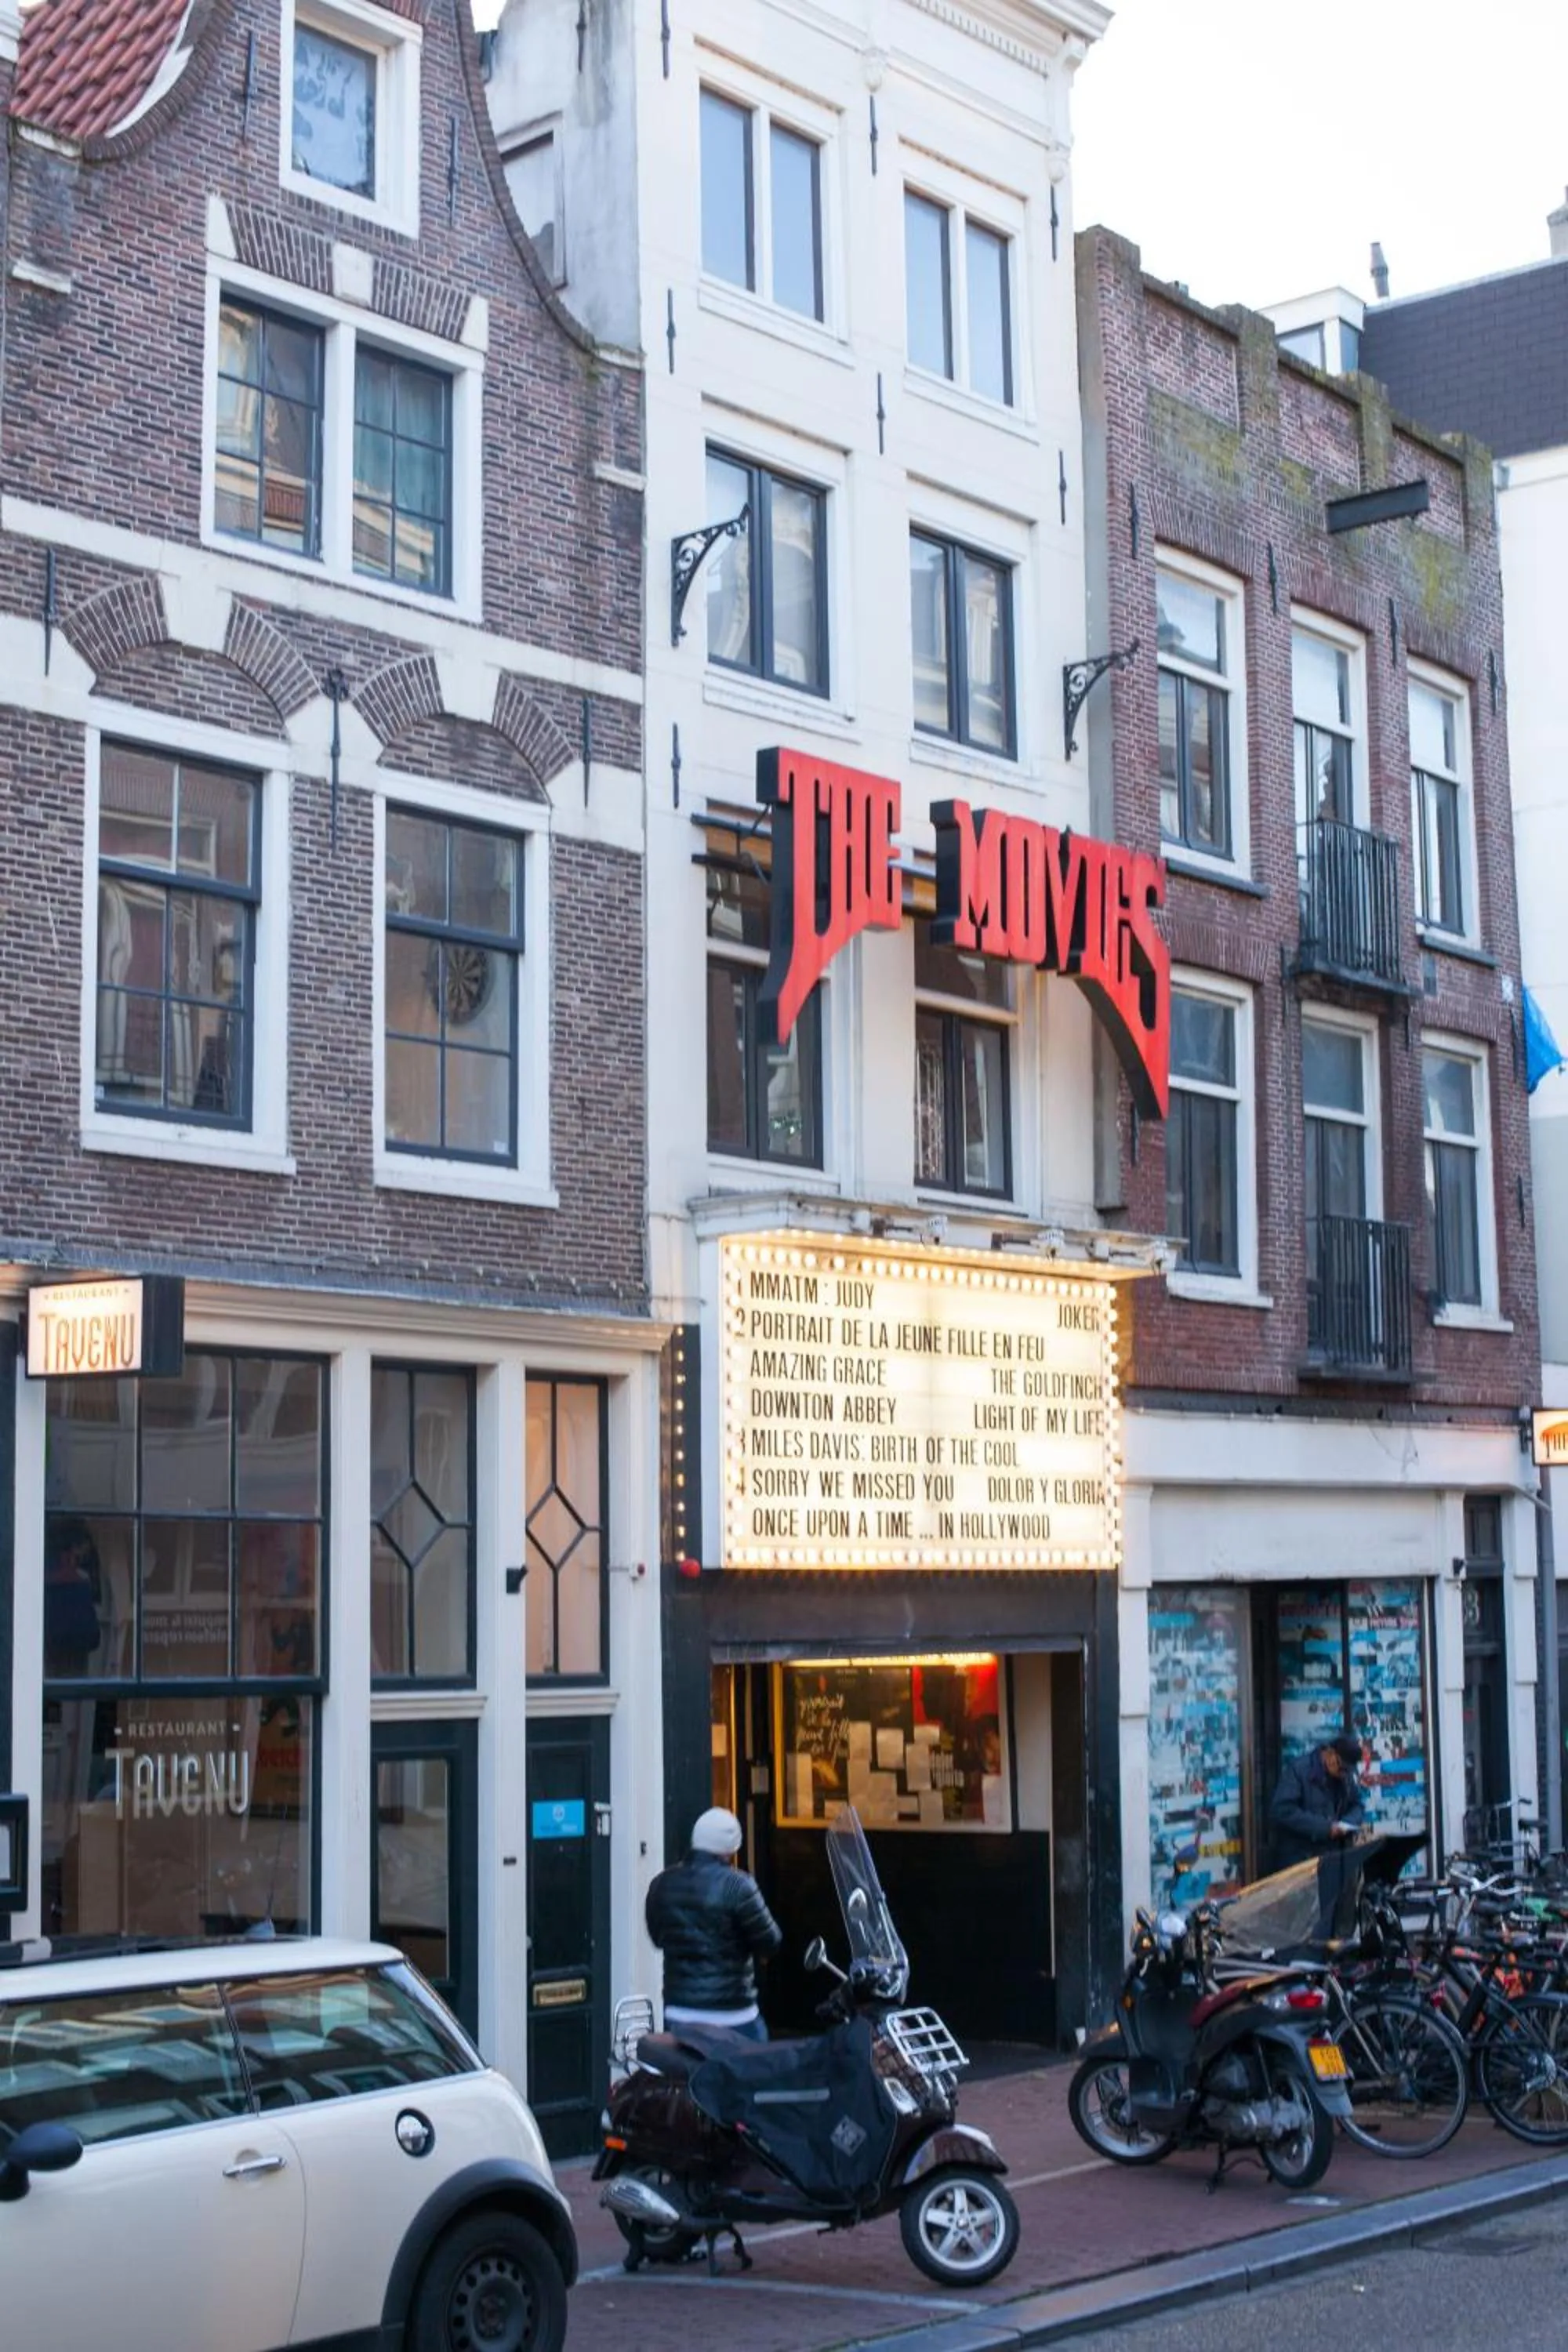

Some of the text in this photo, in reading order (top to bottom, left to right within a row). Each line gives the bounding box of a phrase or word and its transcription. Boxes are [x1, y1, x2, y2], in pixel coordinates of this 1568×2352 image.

[764, 746, 1171, 1121] THE MOVIES
[53, 1287, 118, 1301] RESTAURANT
[750, 1271, 818, 1304] MMATM
[836, 1279, 874, 1310] JUDY
[1057, 1304, 1100, 1332] JOKER
[751, 1310, 833, 1344] PORTRAIT
[842, 1319, 862, 1346] DE
[870, 1322, 888, 1348] LA
[895, 1323, 942, 1353] JEUNE
[948, 1328, 987, 1357] FILLE
[993, 1332, 1012, 1359] EN
[1018, 1334, 1044, 1361] FEU
[750, 1349, 887, 1387] AMAZING GRACE
[991, 1368, 1103, 1399] THE GOLDFINCH
[752, 1388, 896, 1424] DOWNTON ABBEY
[975, 1403, 1105, 1436] LIGHT OF MY LIFE
[752, 1428, 804, 1458] MILES
[871, 1434, 916, 1463] BIRTH
[926, 1436, 946, 1464] OF
[950, 1438, 978, 1466] THE
[984, 1439, 1021, 1467] COOL
[753, 1468, 809, 1497] SORRY
[819, 1470, 844, 1498] WE
[853, 1472, 915, 1501] MISSED
[923, 1473, 954, 1502] YOU
[988, 1475, 1105, 1505] DOLOR Y GLORIA
[753, 1508, 799, 1537] ONCE
[807, 1509, 850, 1538] UPON
[858, 1511, 868, 1538] A
[876, 1510, 913, 1539] TIME
[939, 1512, 954, 1539] IN
[960, 1512, 1051, 1541] HOLLYWOOD
[129, 1720, 227, 1737] RESTAURANT
[104, 1748, 249, 1820] TAVENU
